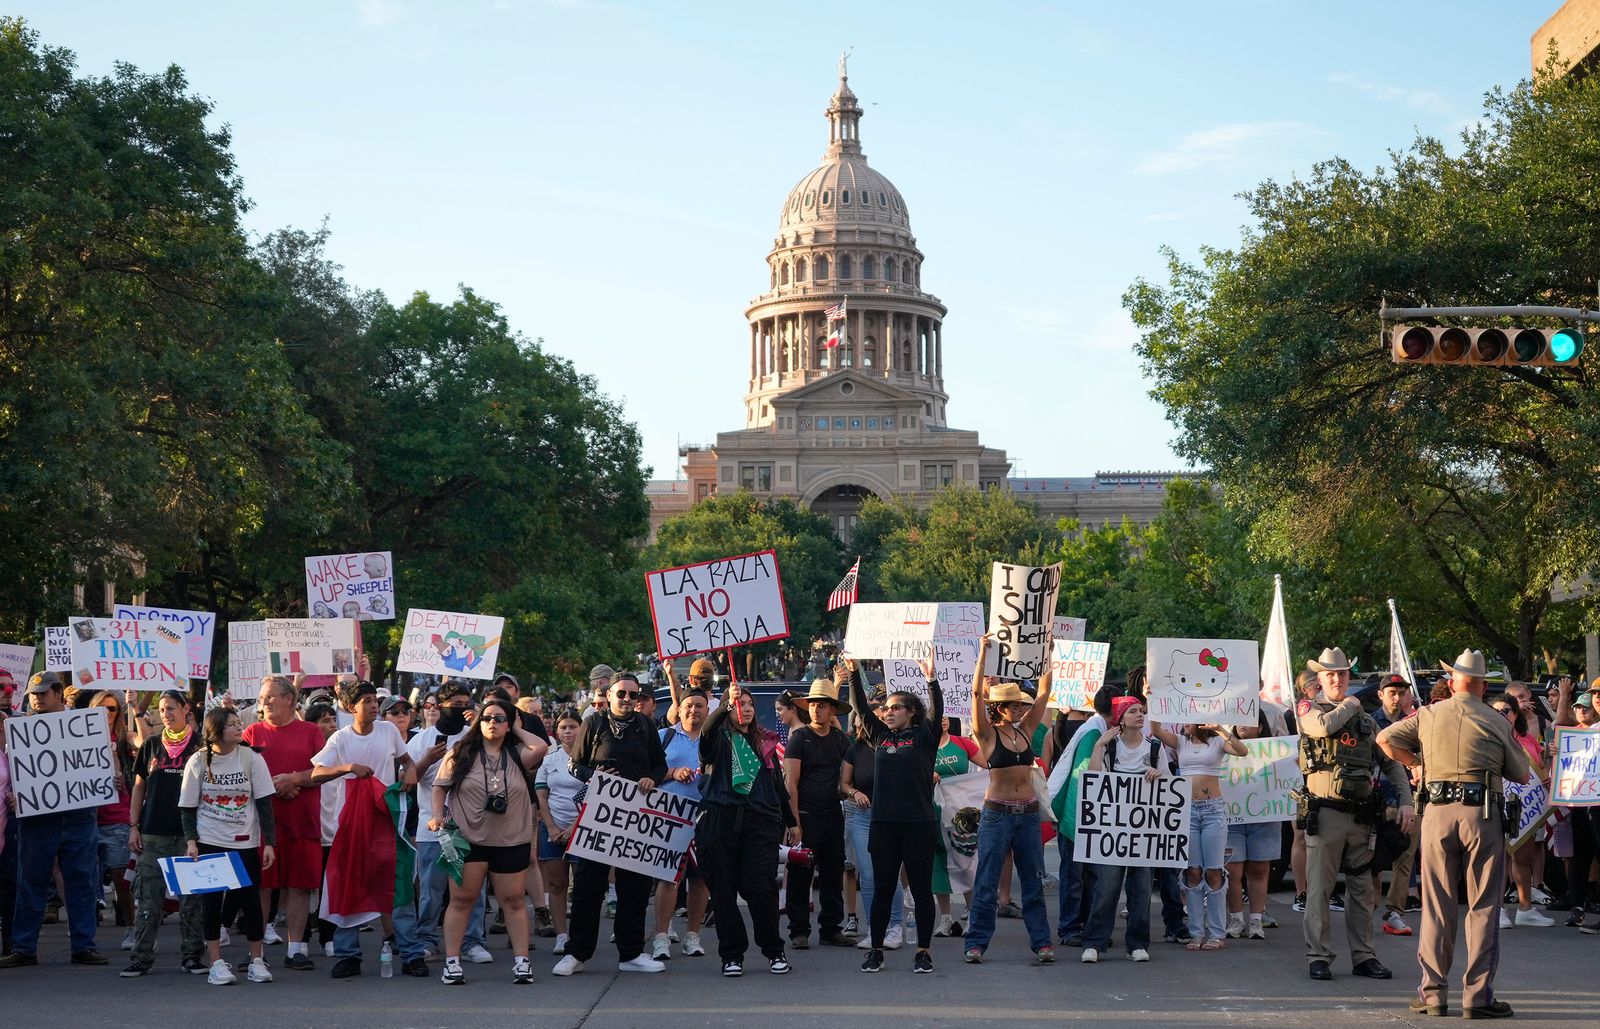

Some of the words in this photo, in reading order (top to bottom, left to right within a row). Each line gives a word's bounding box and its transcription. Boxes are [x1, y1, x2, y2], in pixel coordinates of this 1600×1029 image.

[307, 555, 361, 587] WAKE
[660, 568, 699, 596] LA
[707, 554, 770, 587] RAZA
[1001, 565, 1014, 590] I
[1027, 565, 1060, 593] COULD
[320, 582, 344, 603] UP
[346, 577, 393, 596] SHEEPLE!
[684, 588, 730, 621] NO
[905, 605, 932, 622] NOT
[937, 606, 954, 623] NE
[958, 605, 980, 623] IS
[998, 589, 1054, 626] SHIT
[109, 620, 141, 640] 34
[231, 624, 248, 639] NOT
[410, 611, 479, 633] DEATH
[934, 623, 981, 637] LEGAL
[47, 628, 71, 638] FUC
[157, 625, 181, 641] DUMP
[267, 629, 279, 638] Not
[407, 633, 424, 644] TO
[667, 626, 697, 656] SE
[703, 614, 770, 649] RAJA
[997, 622, 1012, 643] a
[1017, 626, 1050, 644] bette
[48, 639, 66, 647] NO
[48, 648, 71, 656] ILLE
[95, 639, 158, 659] TIME
[230, 642, 266, 660] PROTES
[268, 639, 281, 648] The
[286, 639, 320, 648] President
[889, 640, 933, 659] HUMANS
[1057, 642, 1080, 660] WE
[1081, 643, 1106, 661] THE
[48, 655, 72, 666] STOL
[401, 648, 439, 666] TYRANTS
[935, 645, 964, 663] Here.
[997, 642, 1050, 679] Preside
[94, 660, 176, 682] FELON
[188, 663, 208, 677] IES
[894, 661, 948, 681] Bloced
[951, 667, 973, 684] Ther
[233, 680, 254, 698] FOR
[955, 685, 973, 701] Figh
[1084, 680, 1099, 692] NO
[1057, 693, 1083, 708] KING
[1208, 697, 1256, 718] MIGRA
[944, 706, 972, 716] IMMIGRAN
[10, 719, 51, 749] NO
[59, 713, 102, 739] ICE
[1562, 735, 1577, 753] I
[14, 750, 57, 781] NO
[62, 745, 111, 772] NAZIS
[934, 755, 958, 766] XICO
[1561, 756, 1597, 772] WARM
[204, 770, 247, 781] CLECTIVE
[17, 781, 60, 814] NO
[66, 776, 114, 804] KINGS
[597, 775, 638, 802] YOU
[1082, 773, 1186, 808] FAMILIES
[1559, 777, 1597, 797] FUCK
[594, 802, 683, 843] DEPORT
[1081, 801, 1181, 831] BELONG
[576, 825, 611, 853] THE
[609, 835, 683, 870] RESISTANC
[1078, 828, 1188, 861] TOGETHER
